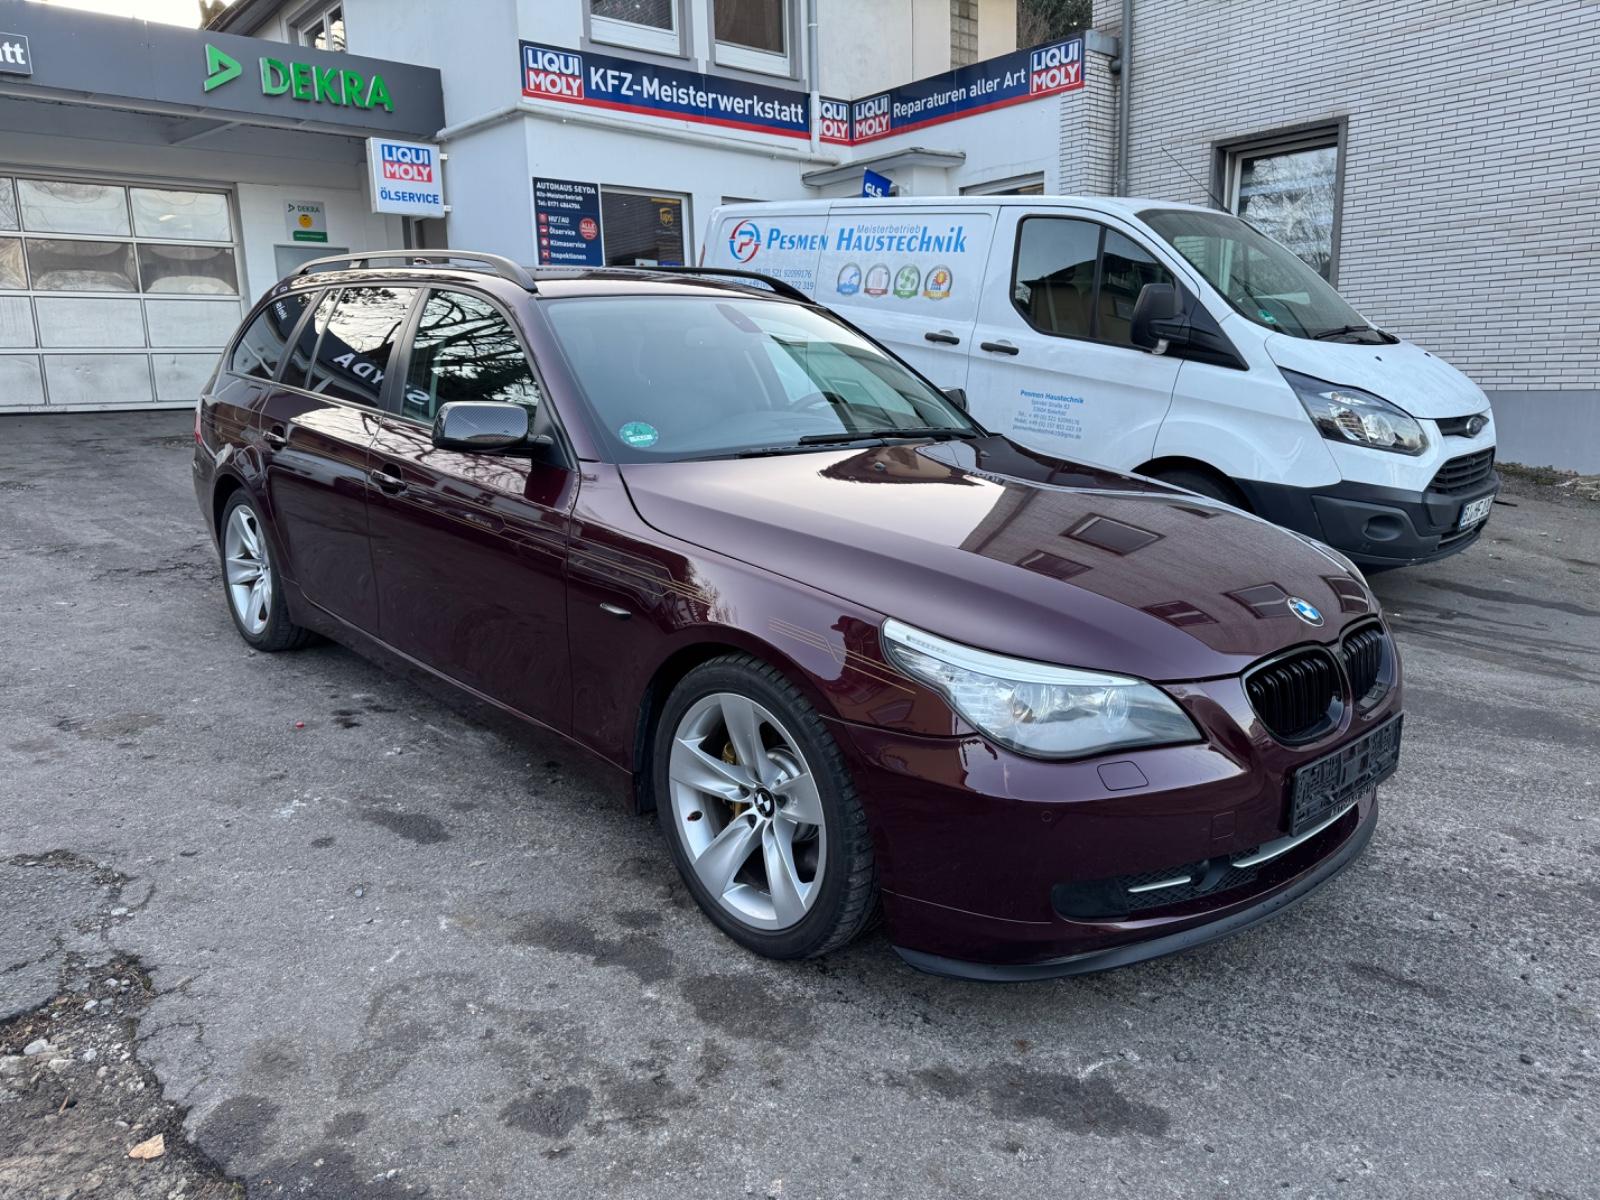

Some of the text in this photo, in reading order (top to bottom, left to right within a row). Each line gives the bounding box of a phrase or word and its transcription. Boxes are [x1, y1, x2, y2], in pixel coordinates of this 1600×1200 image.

[0, 41, 26, 65] tt
[527, 50, 580, 76] LIQUI
[1033, 41, 1079, 71] LIQUI
[259, 57, 394, 112] DEKRA
[529, 71, 582, 97] MOLY
[1032, 63, 1080, 93] MOLY
[590, 66, 804, 124] KFZ-Meisterwerkstatt
[893, 69, 1026, 119] Reparaturen aller Art
[855, 97, 888, 120] LIQUI
[855, 115, 889, 138] MOLY
[383, 145, 430, 165] LIQUI
[385, 163, 431, 181] MOLY
[380, 187, 440, 205] ÖLSERVICE
[536, 181, 596, 195] AUTOHAUS SEYDA
[865, 183, 882, 197] GLS
[767, 228, 829, 250] PESMEN
[857, 225, 920, 234] Meisterbetrieb
[550, 240, 586, 249] Klimaservice
